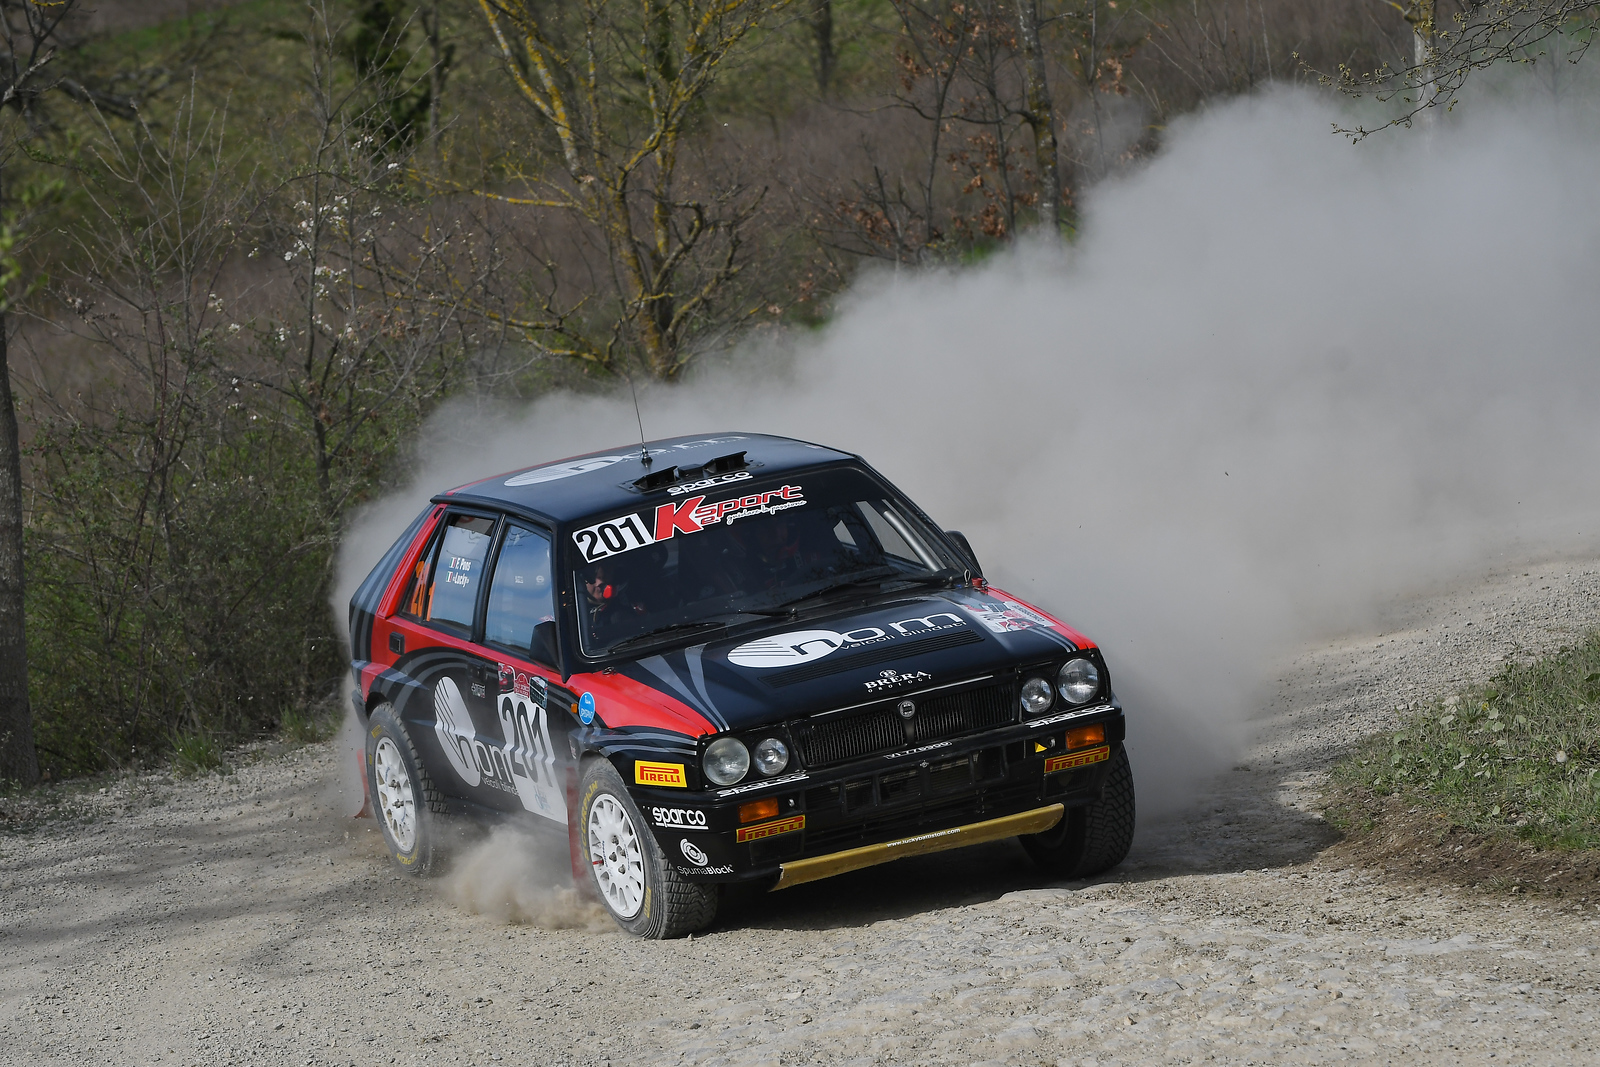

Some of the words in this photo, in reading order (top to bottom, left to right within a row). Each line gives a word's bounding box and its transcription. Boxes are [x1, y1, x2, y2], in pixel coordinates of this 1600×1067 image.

[666, 471, 752, 494] sparco
[575, 517, 648, 561] 201
[792, 612, 965, 656] nom
[841, 634, 896, 651] veicoli
[900, 620, 967, 638] blindati
[864, 671, 932, 689] BRERA
[1025, 704, 1112, 727] sparco
[502, 696, 553, 788] 201
[1045, 746, 1108, 773] PIRELLI
[639, 765, 681, 784] PIRELLI
[652, 805, 707, 828] sparco
[737, 815, 805, 843] PIRELLI
